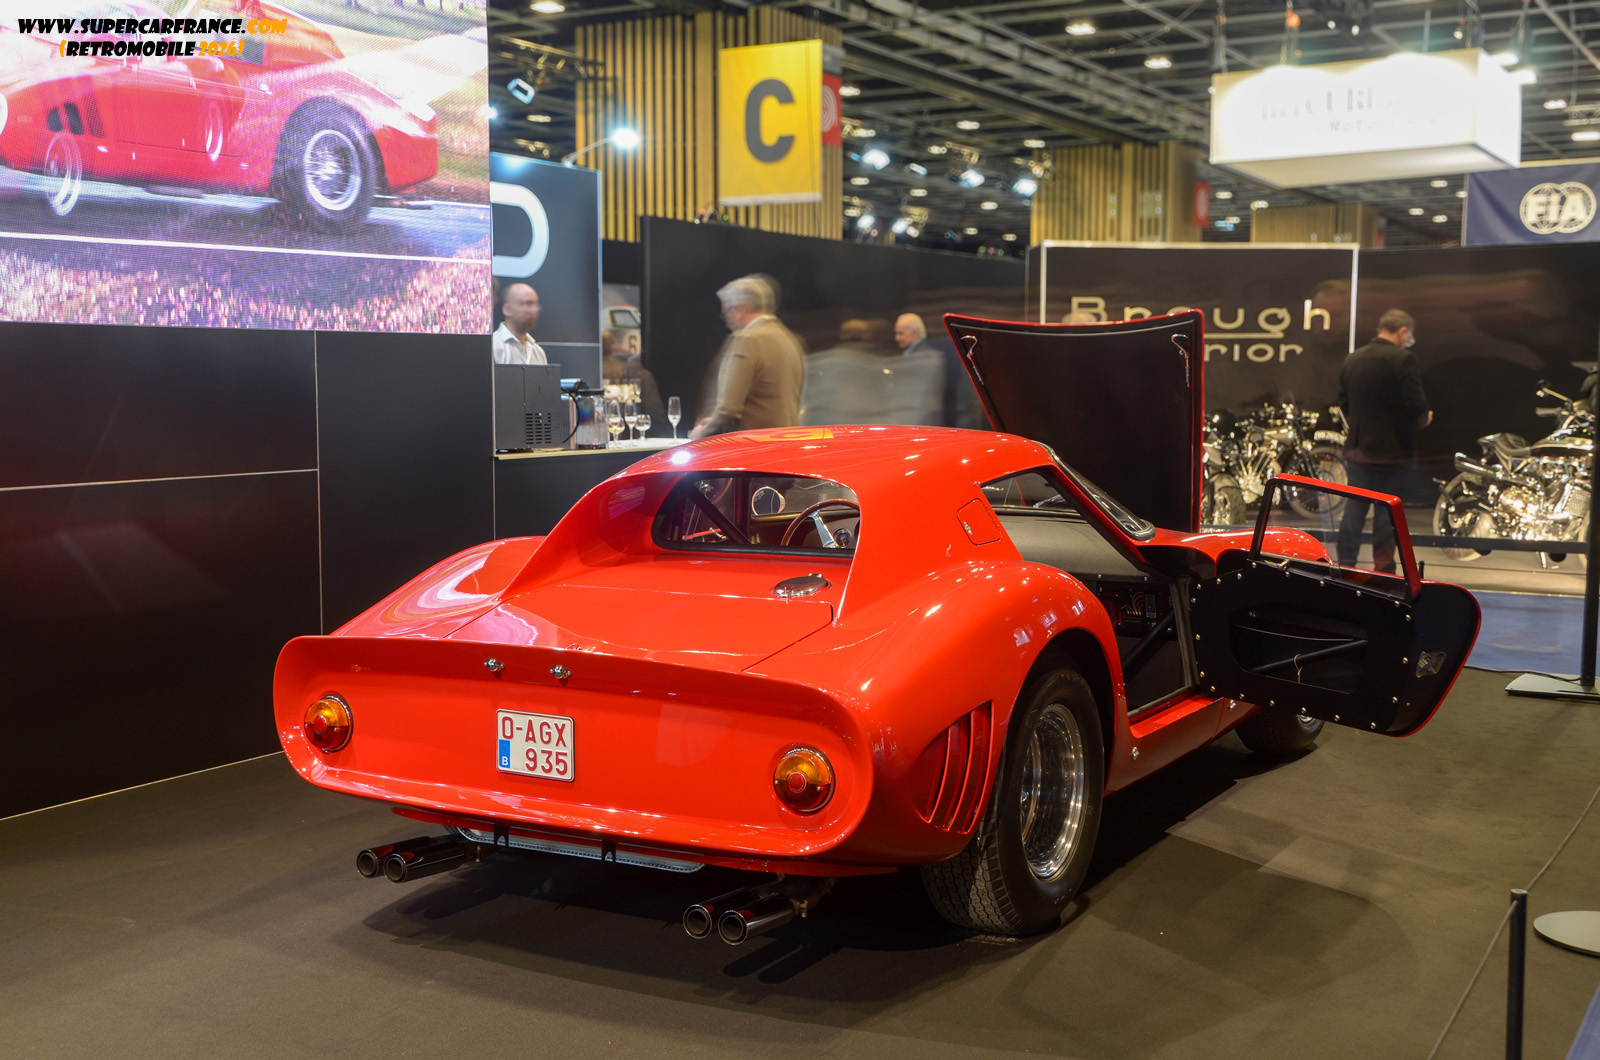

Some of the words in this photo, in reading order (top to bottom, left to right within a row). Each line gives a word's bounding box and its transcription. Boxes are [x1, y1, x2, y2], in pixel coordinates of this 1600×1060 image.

[745, 78, 796, 163] C
[1525, 191, 1590, 225] FIA
[1070, 296, 1331, 338] Brugh
[501, 755, 509, 767] B
[524, 747, 568, 776] 935
